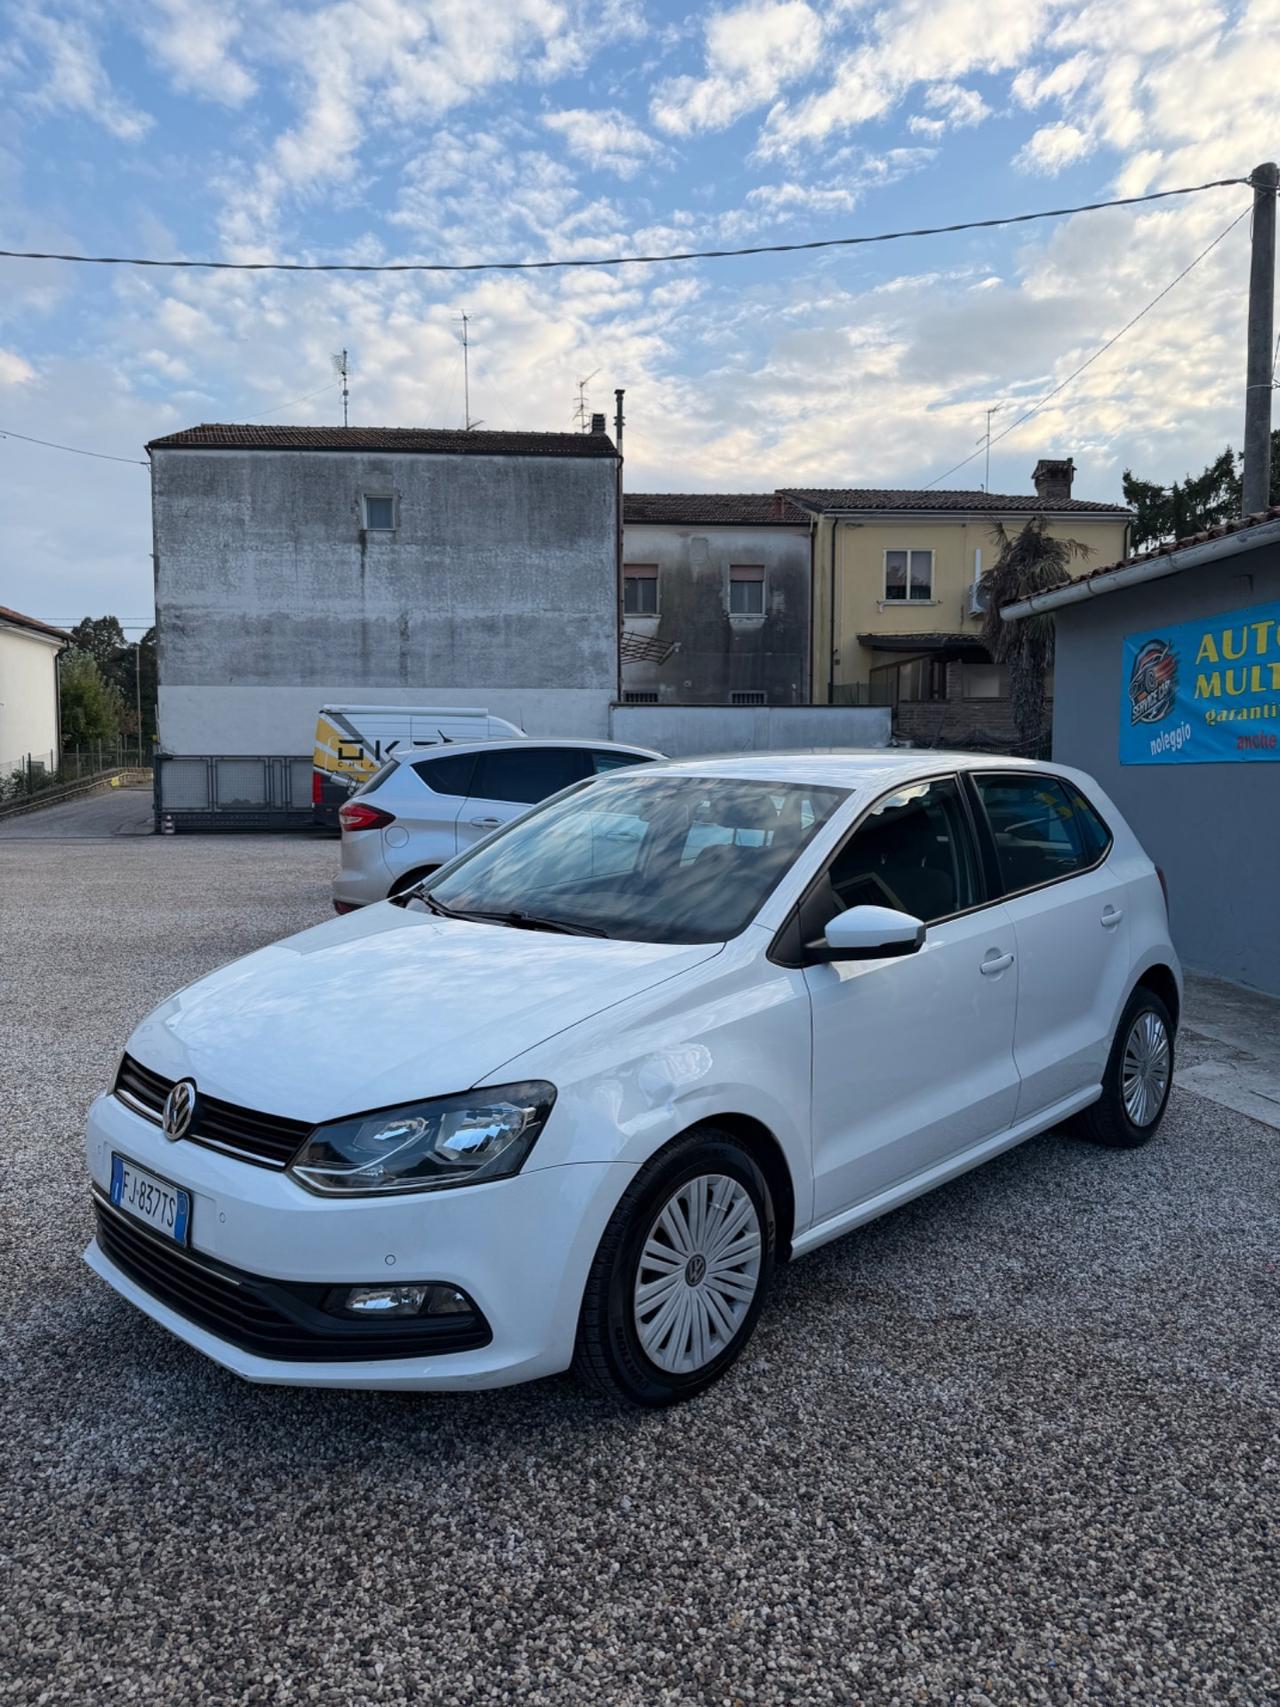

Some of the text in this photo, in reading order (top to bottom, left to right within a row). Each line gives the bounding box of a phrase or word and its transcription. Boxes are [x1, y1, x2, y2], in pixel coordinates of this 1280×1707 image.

[1195, 620, 1280, 665] AUT
[1205, 702, 1280, 726] garanti
[1150, 720, 1191, 756] noleggio
[1237, 730, 1277, 751] anche
